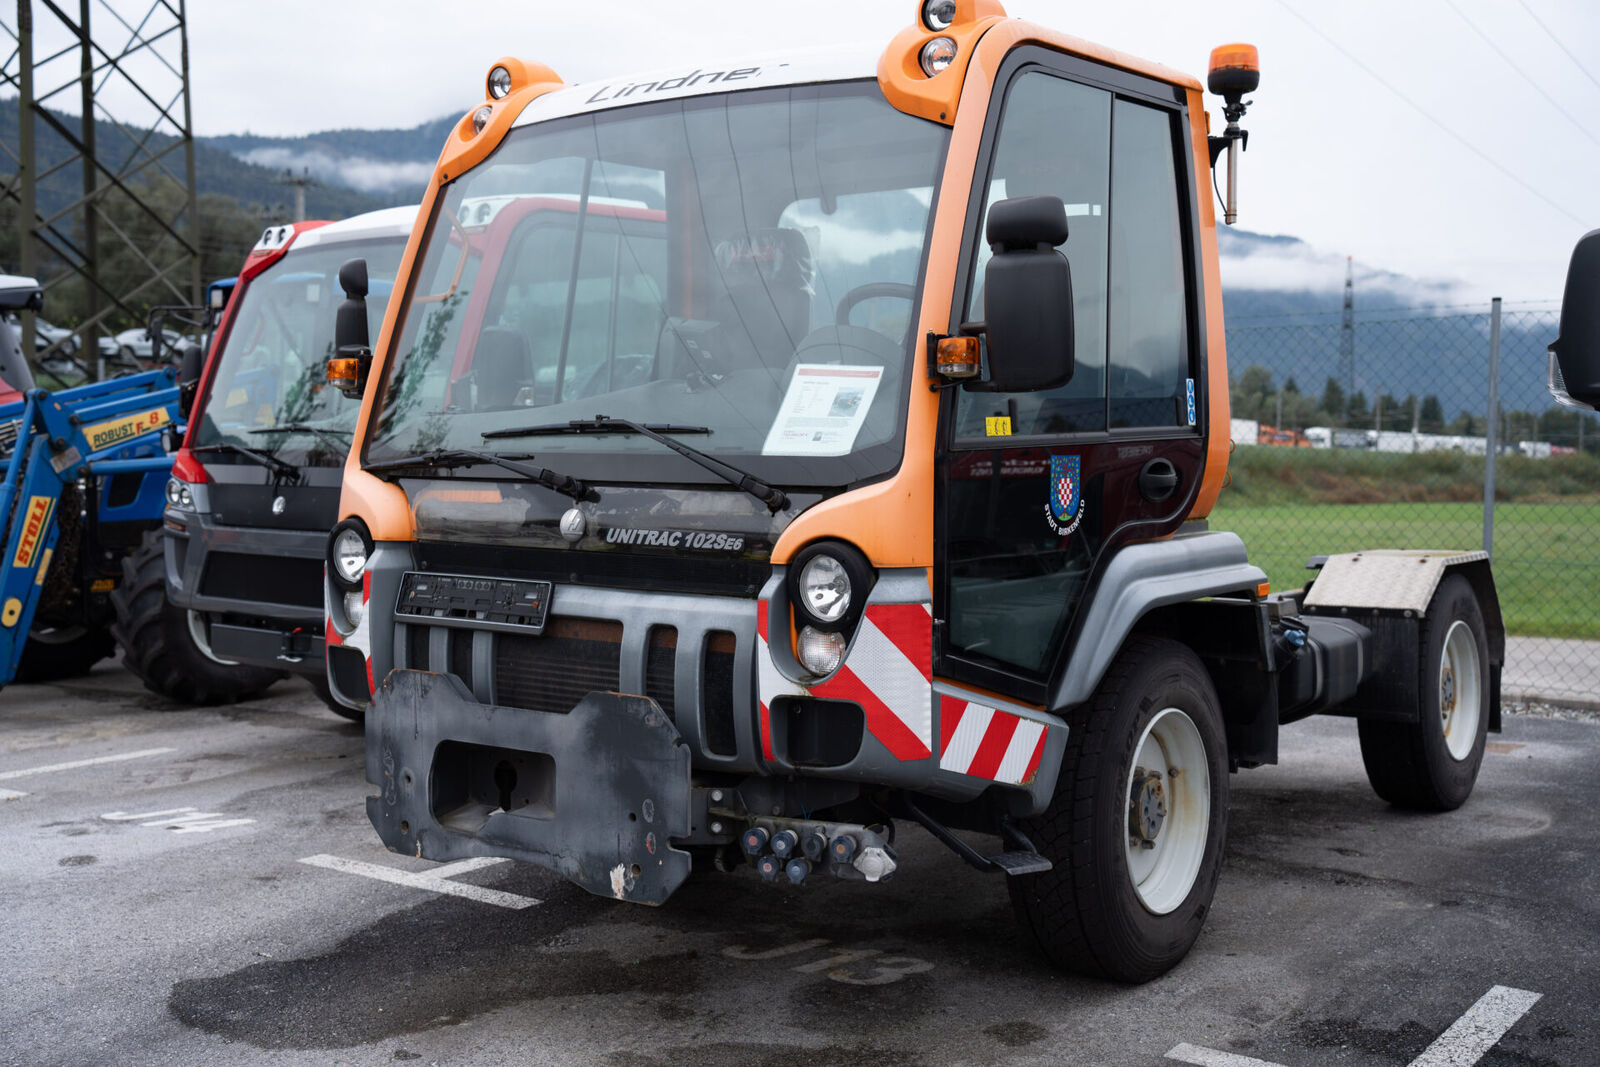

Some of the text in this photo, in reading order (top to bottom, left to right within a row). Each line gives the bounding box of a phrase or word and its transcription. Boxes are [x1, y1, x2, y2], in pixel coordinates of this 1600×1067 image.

[585, 67, 761, 104] Lindne
[93, 411, 160, 444] ROBUST F 8
[18, 499, 48, 565] STOLL
[1044, 499, 1086, 537] STADT BIRKENFELD
[606, 528, 682, 546] UNITRAC
